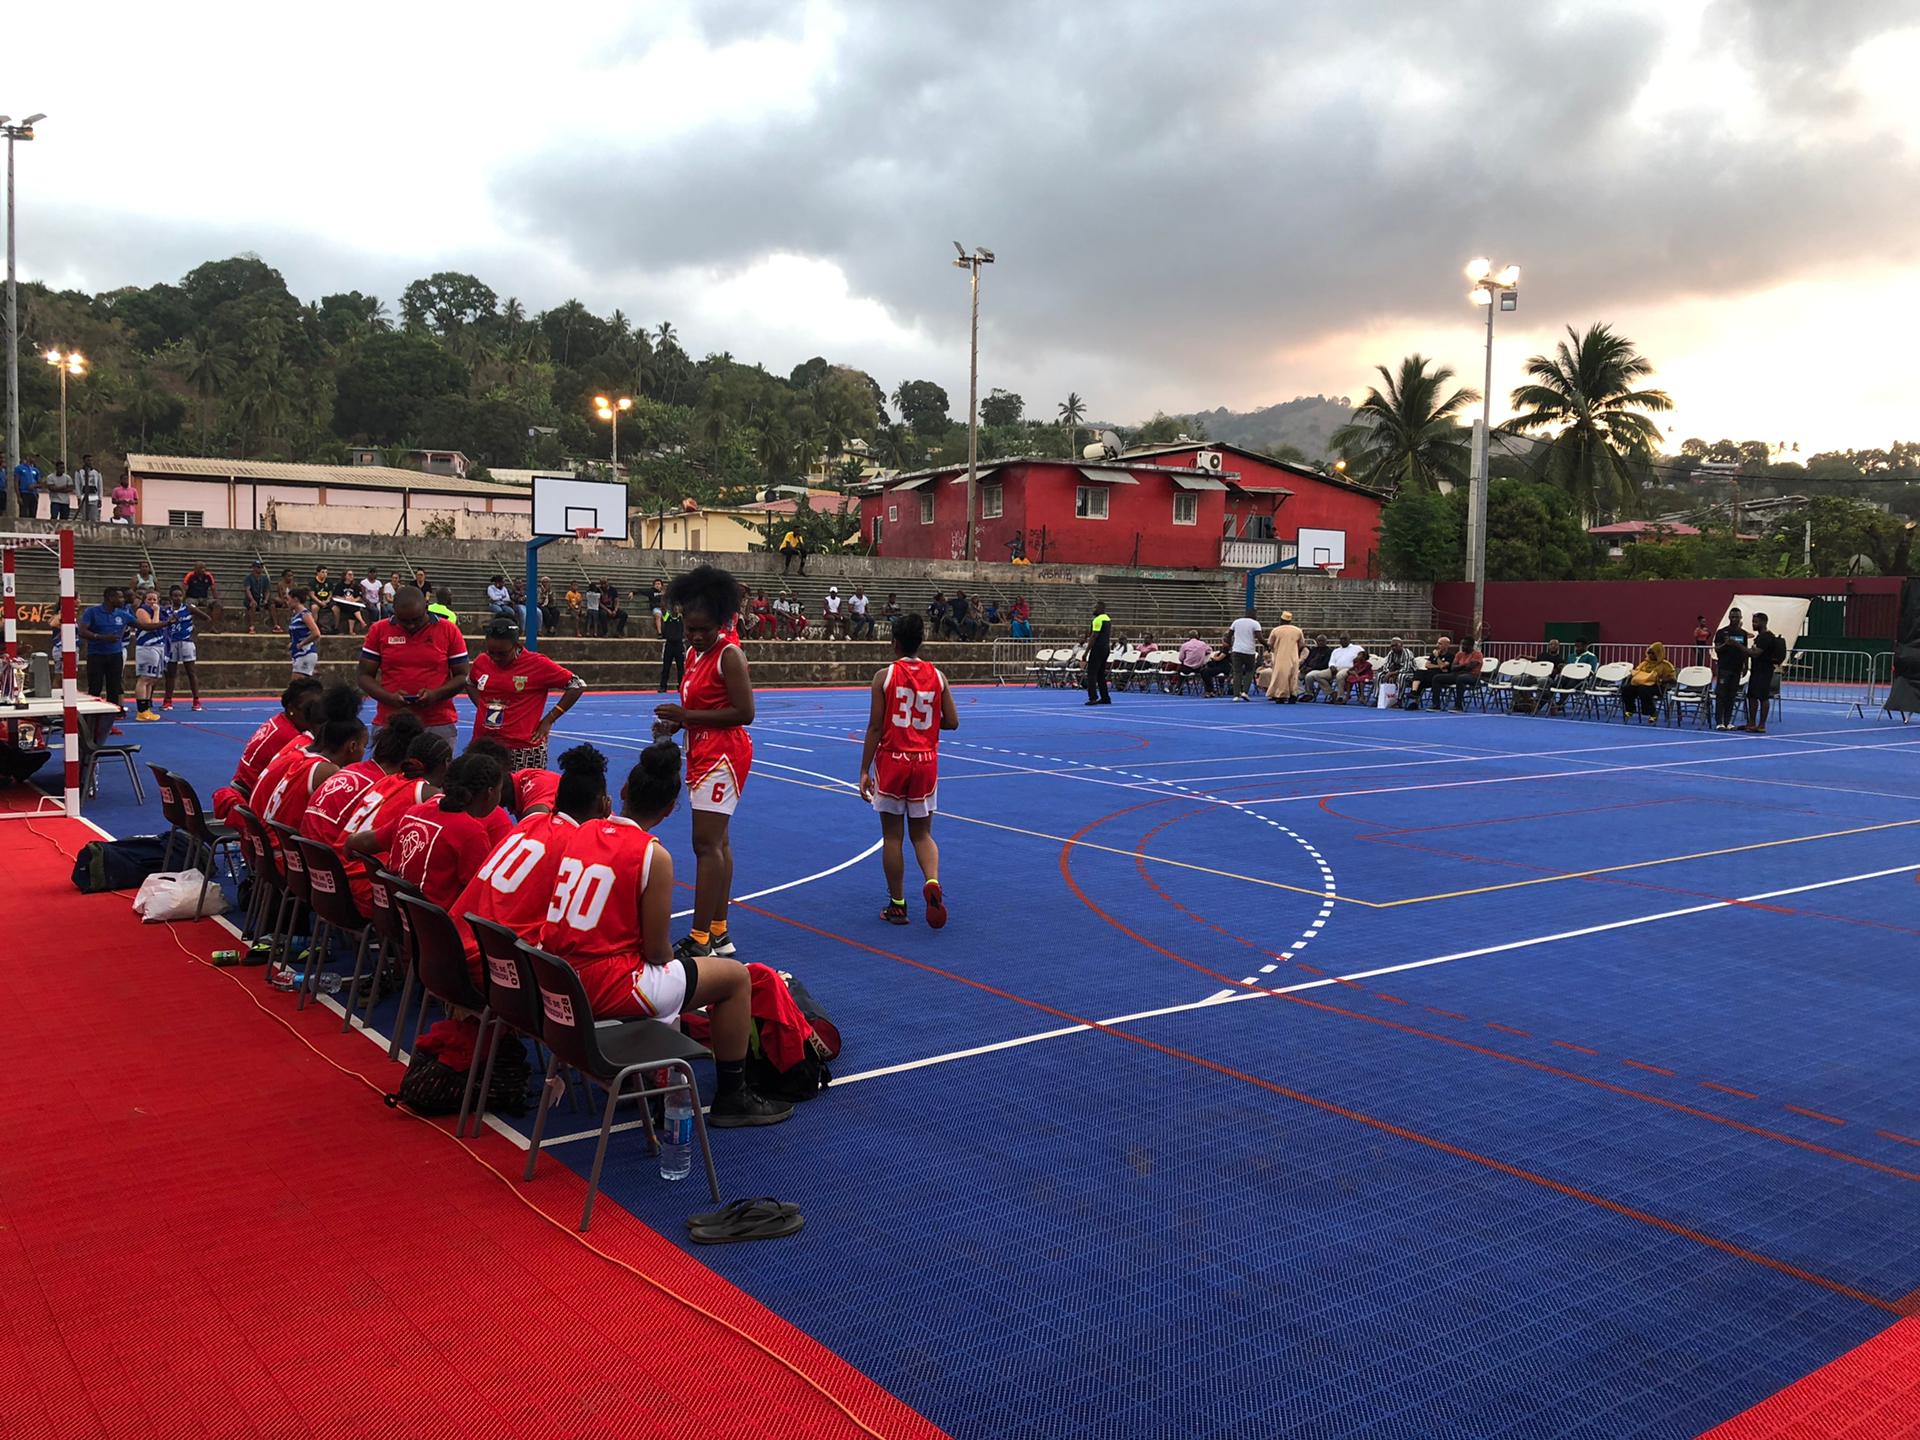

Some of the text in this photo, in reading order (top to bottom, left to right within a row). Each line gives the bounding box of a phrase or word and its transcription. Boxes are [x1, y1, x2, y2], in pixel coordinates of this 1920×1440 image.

[891, 686, 935, 730] 35
[710, 782, 725, 803] 6
[477, 832, 546, 894] 10
[547, 857, 616, 932] 30
[507, 962, 518, 986] 073
[561, 997, 573, 1022] 128
